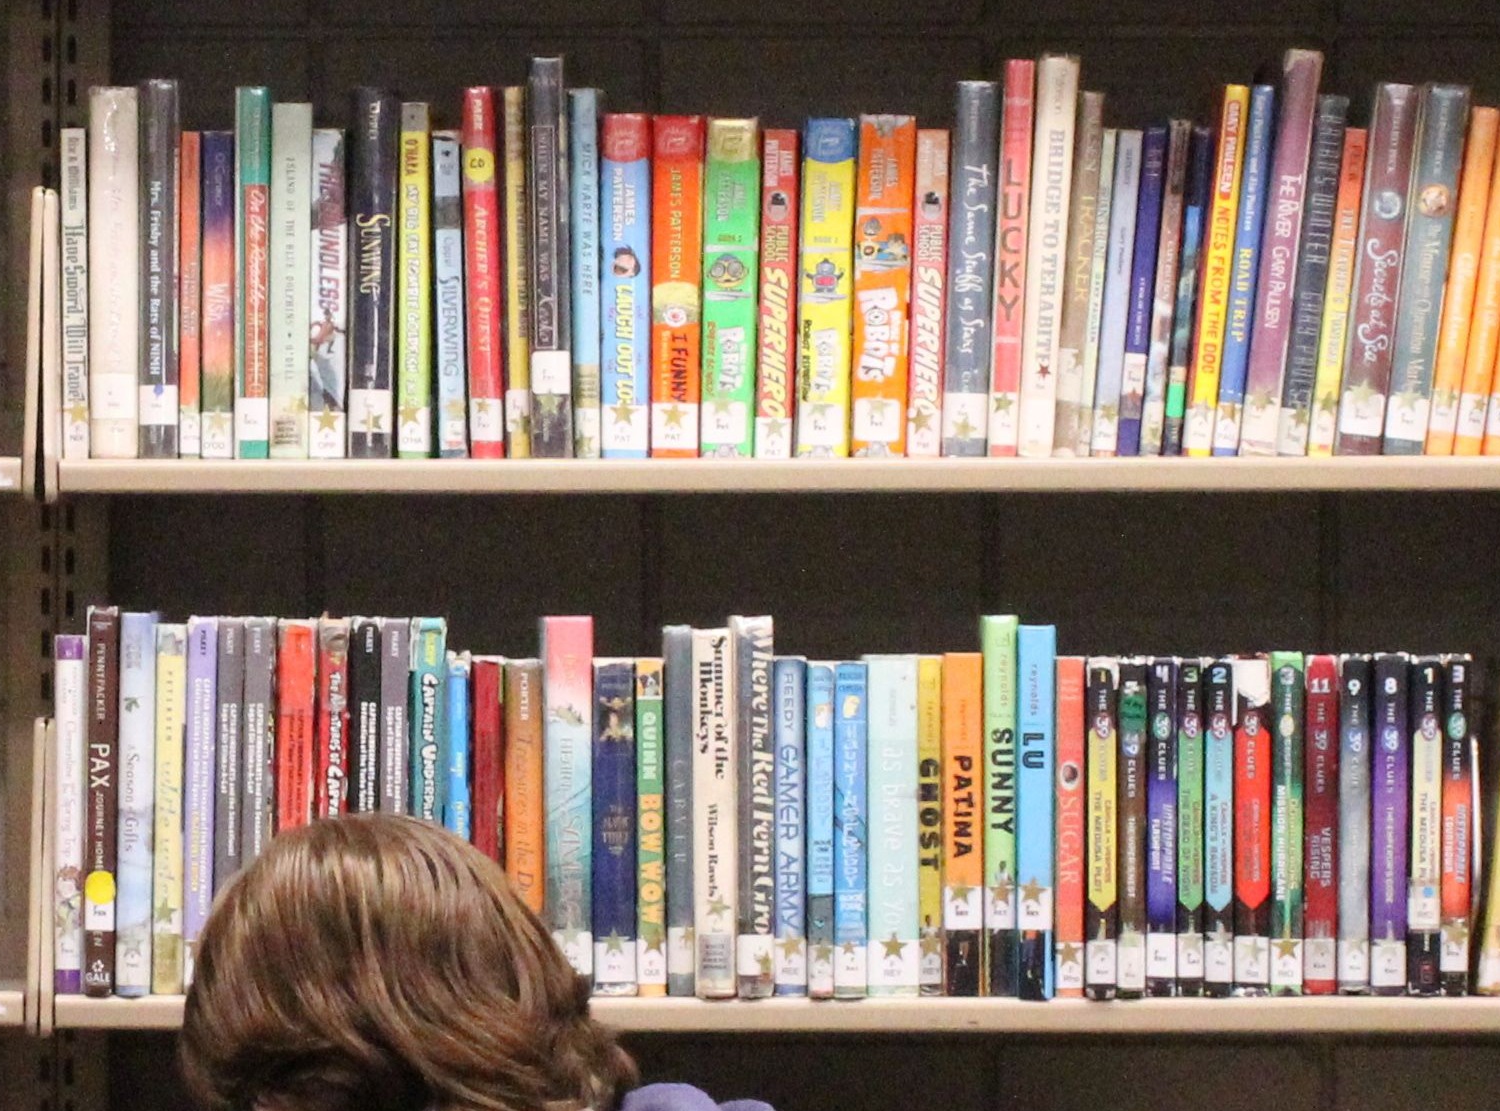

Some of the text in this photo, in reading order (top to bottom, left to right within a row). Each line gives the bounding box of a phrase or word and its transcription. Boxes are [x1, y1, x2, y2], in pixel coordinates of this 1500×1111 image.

[537, 134, 552, 343] WHEN MY NAME WAS Keoko
[612, 168, 624, 241] PATTERSON
[624, 183, 637, 226] JAMES
[998, 159, 1022, 323] LUCKY
[1042, 130, 1065, 249] BRIDGE TO
[1214, 205, 1231, 251] NOTES
[148, 181, 162, 375] Mrs. Frisby and the Rats of NIMH
[357, 214, 391, 294] SUNWING
[475, 203, 492, 351] ARCHER'S QUEST
[764, 225, 776, 261] SCHOOL
[776, 225, 788, 261] PUBLIC
[955, 166, 989, 353] The Same Stuff as Stars
[1211, 256, 1228, 304] FROM
[1231, 248, 1253, 341] ROAD TRIP
[1265, 175, 1302, 328] THE RIVER GARY PAULSEN
[61, 224, 85, 402] Have Sword, Will Travel
[440, 276, 460, 377] SILVERWING
[616, 285, 634, 373] LAUGH OUT
[763, 268, 790, 417] SUPERHERO
[1208, 311, 1225, 338] THE
[751, 626, 774, 873] Where The Red Fern
[991, 728, 1014, 834] SUNNY
[1023, 732, 1046, 769] LU
[90, 744, 111, 870] PAX JOURNEY HOME
[640, 712, 662, 925] QUINN BOW WOW
[778, 745, 799, 928] GAMER ARMY
[920, 758, 940, 871] GHOST
[953, 755, 975, 857] PATINA
[1060, 796, 1079, 883] SUGAR
